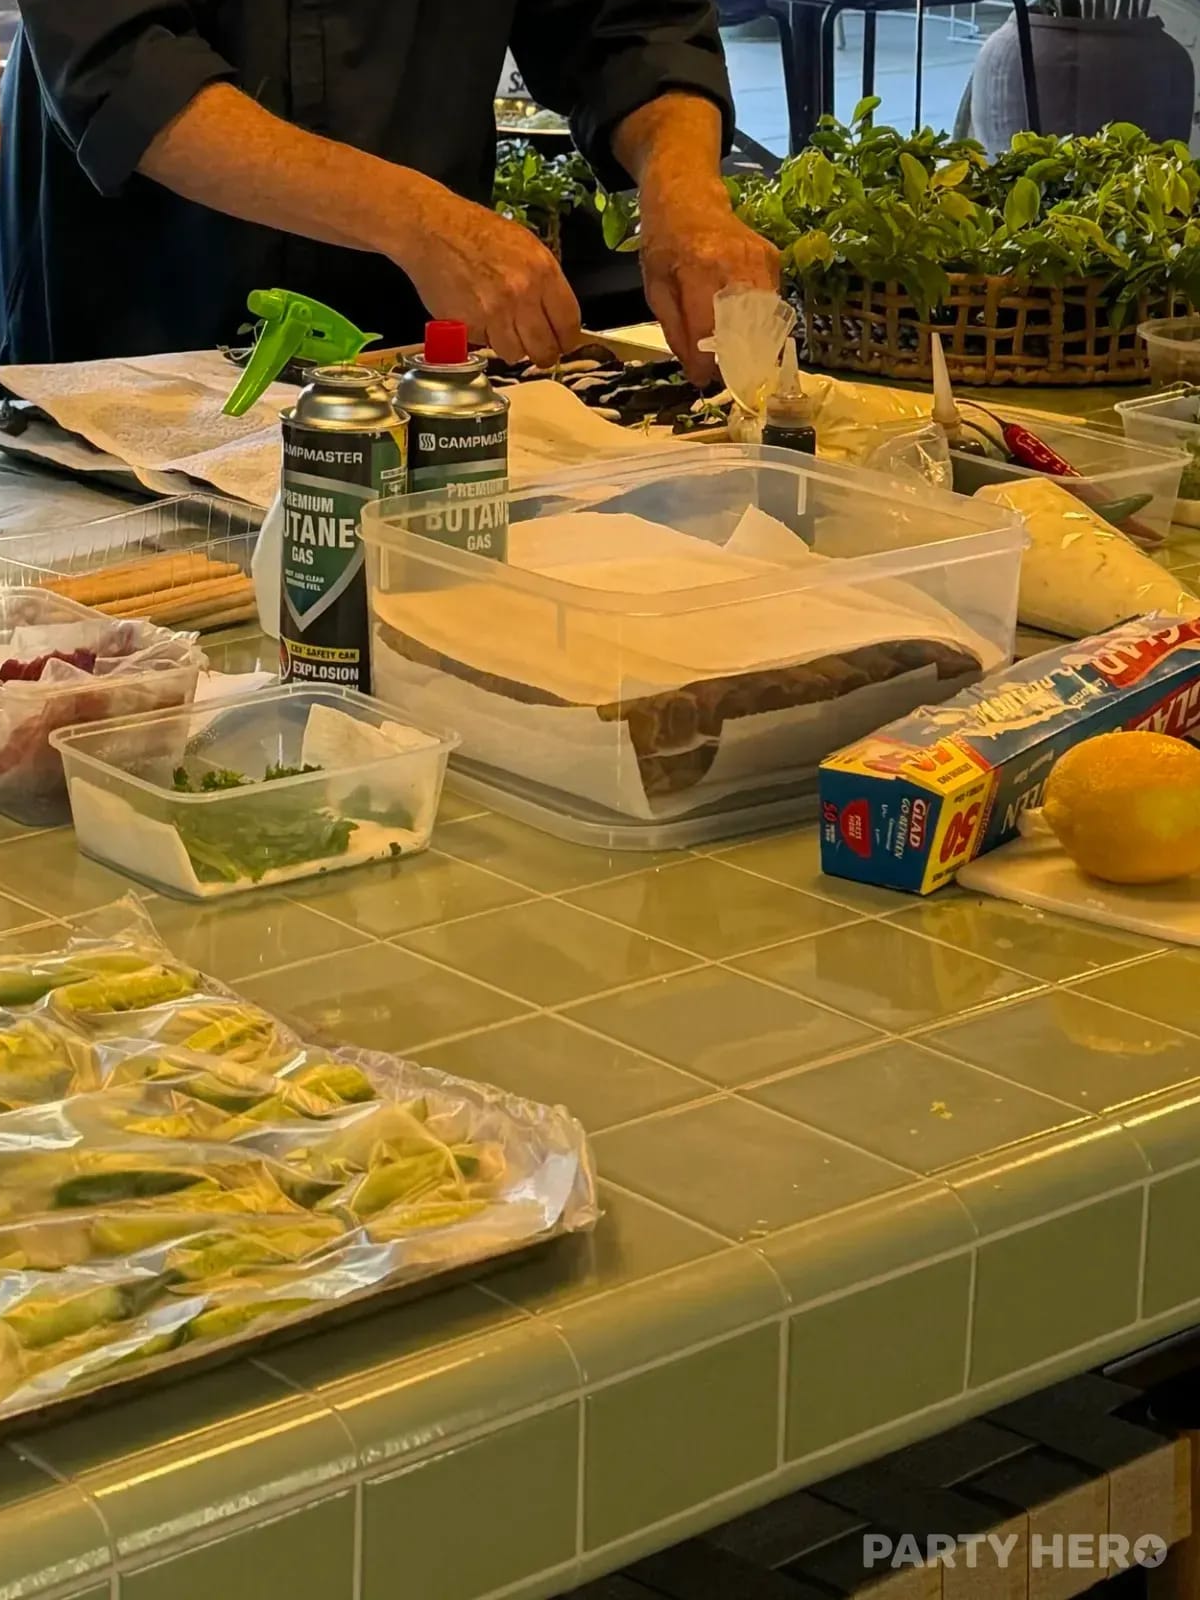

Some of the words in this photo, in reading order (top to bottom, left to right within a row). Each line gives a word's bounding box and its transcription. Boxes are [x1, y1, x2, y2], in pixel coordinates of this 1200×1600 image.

[284, 442, 364, 465] AMPMASTER
[285, 490, 335, 514] REMIUM
[283, 508, 356, 549] UTANE
[467, 534, 492, 551] GAS
[291, 545, 314, 566] GAS
[293, 660, 360, 681] EXPLOSION
[909, 798, 926, 849] GLAD
[939, 802, 982, 864] 50
